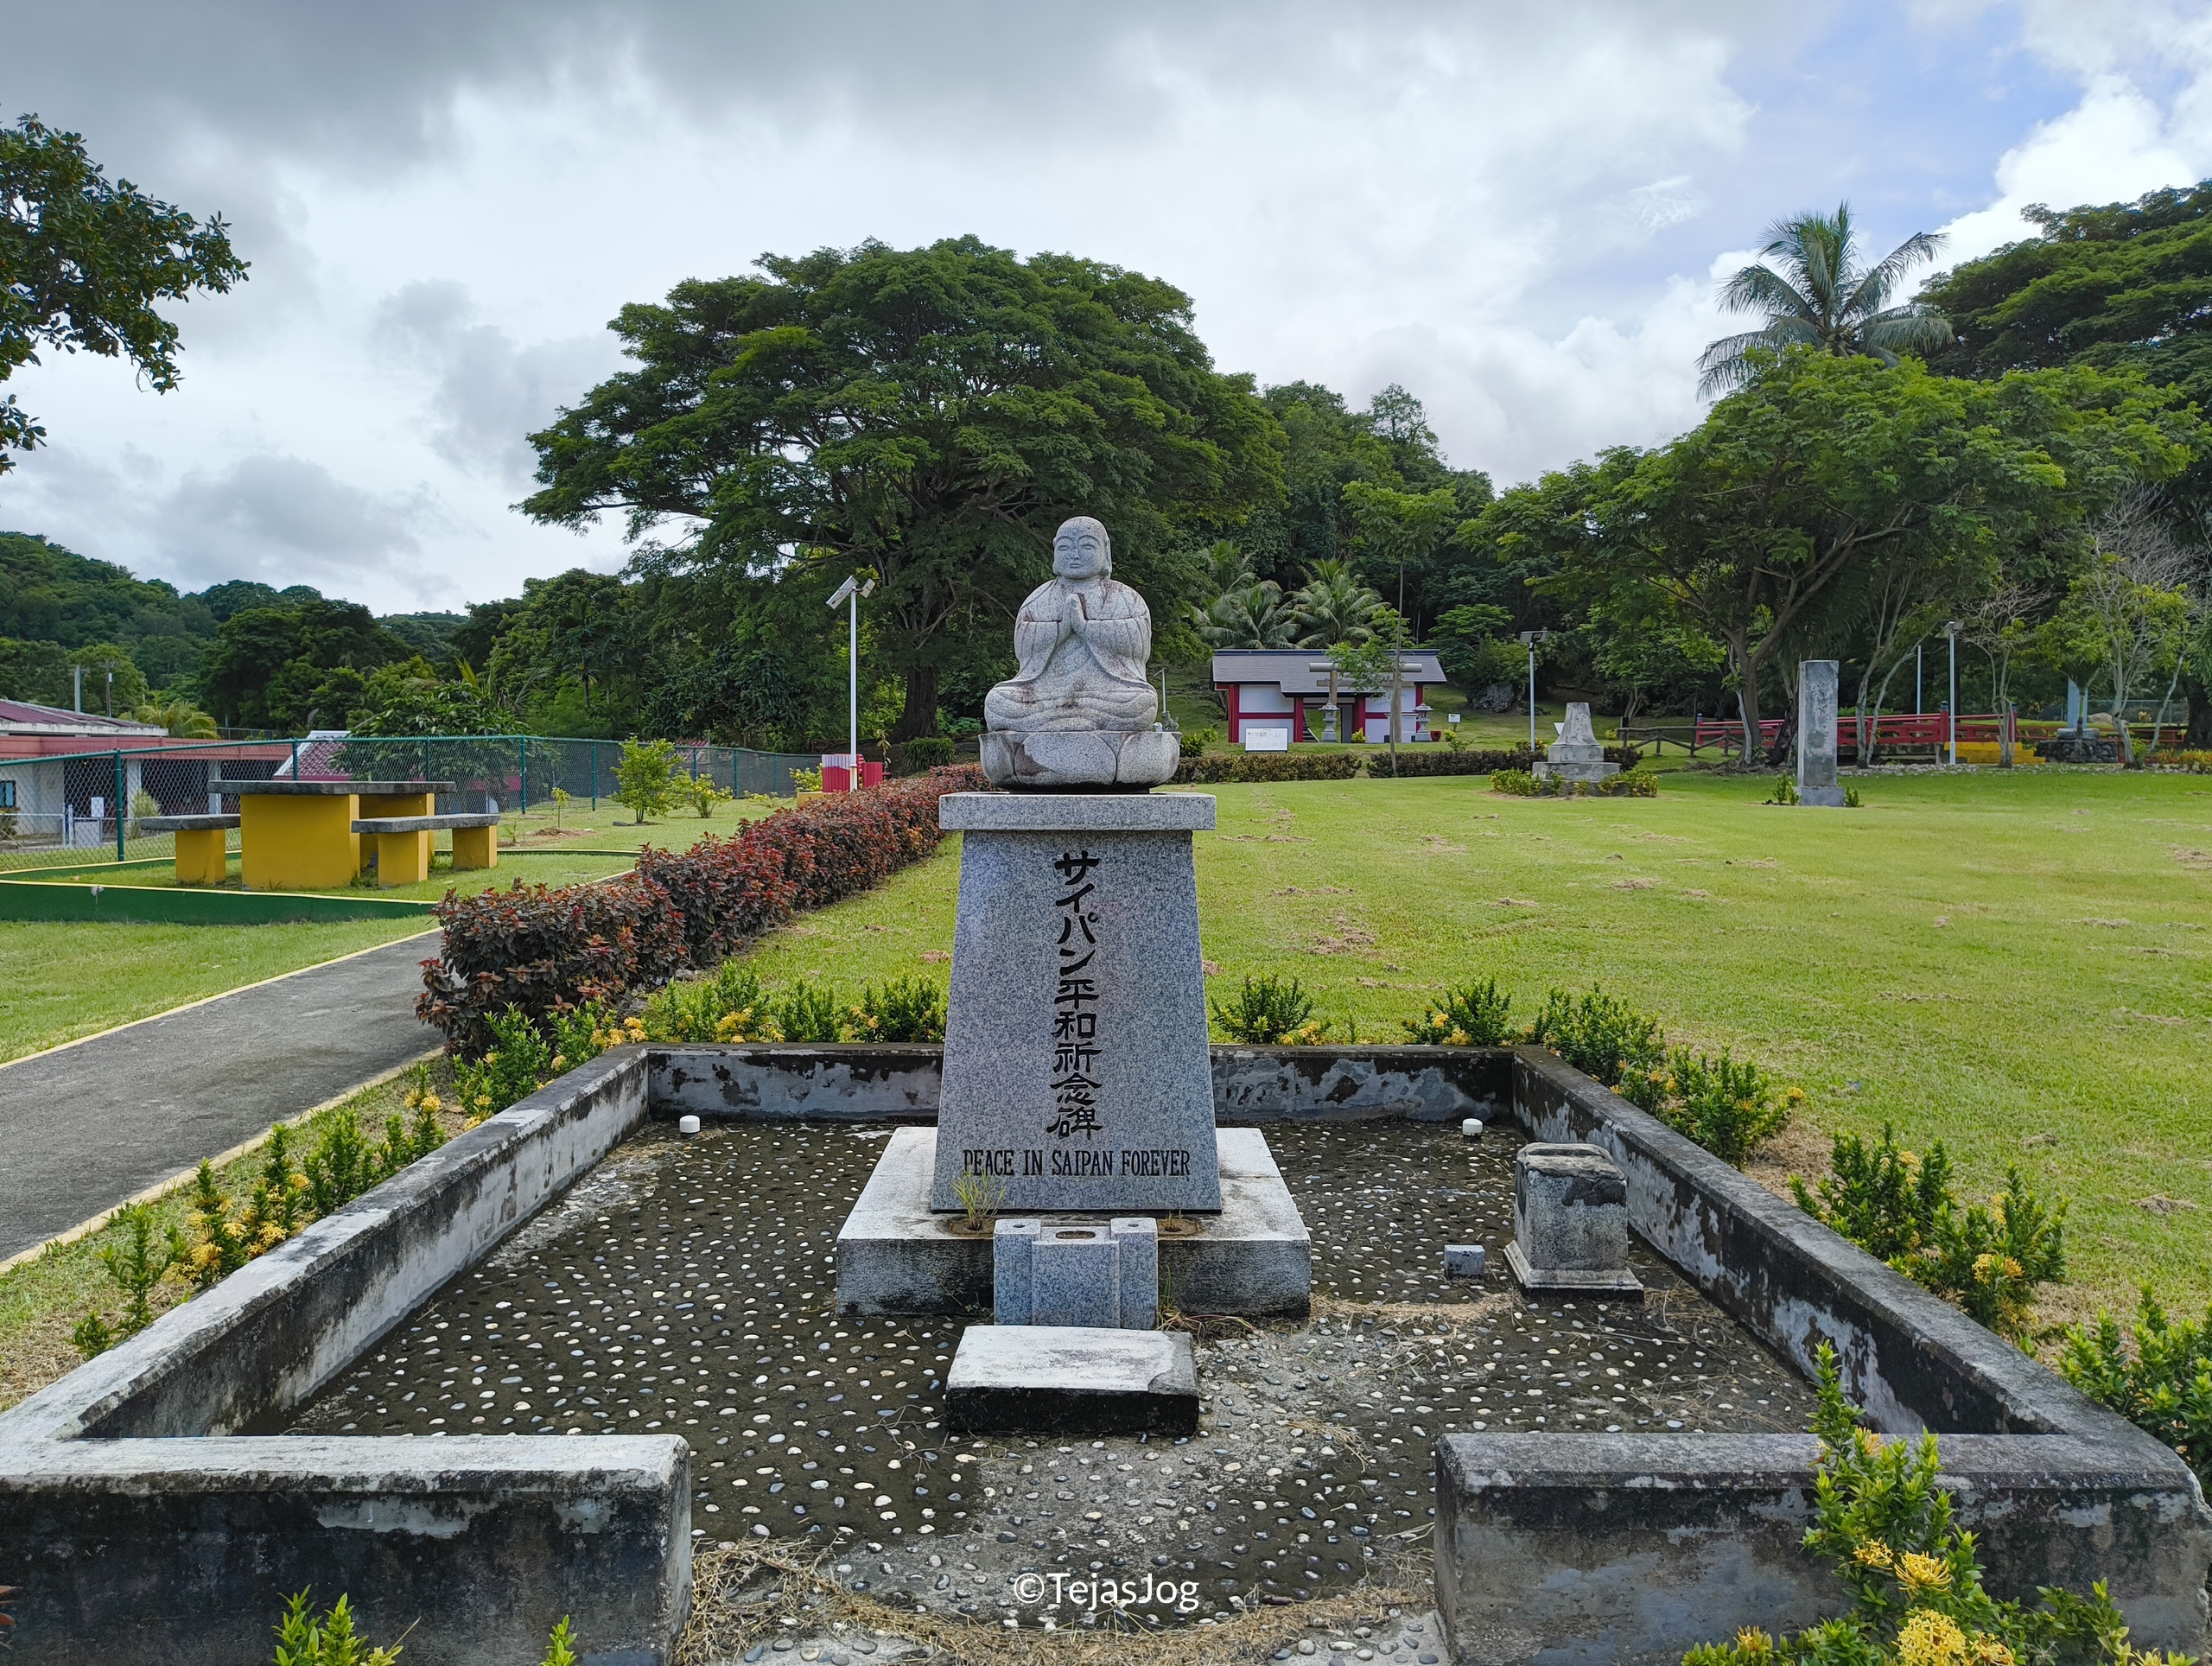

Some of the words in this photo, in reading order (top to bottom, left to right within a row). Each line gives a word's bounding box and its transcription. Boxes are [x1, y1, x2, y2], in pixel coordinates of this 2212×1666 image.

[1046, 850, 1103, 1141] サイパン平和祈念碑
[963, 1149, 1014, 1177] PEACE
[1022, 1149, 1044, 1176] IN
[1052, 1149, 1114, 1177] SAIPAN
[1122, 1149, 1191, 1177] FOREVER
